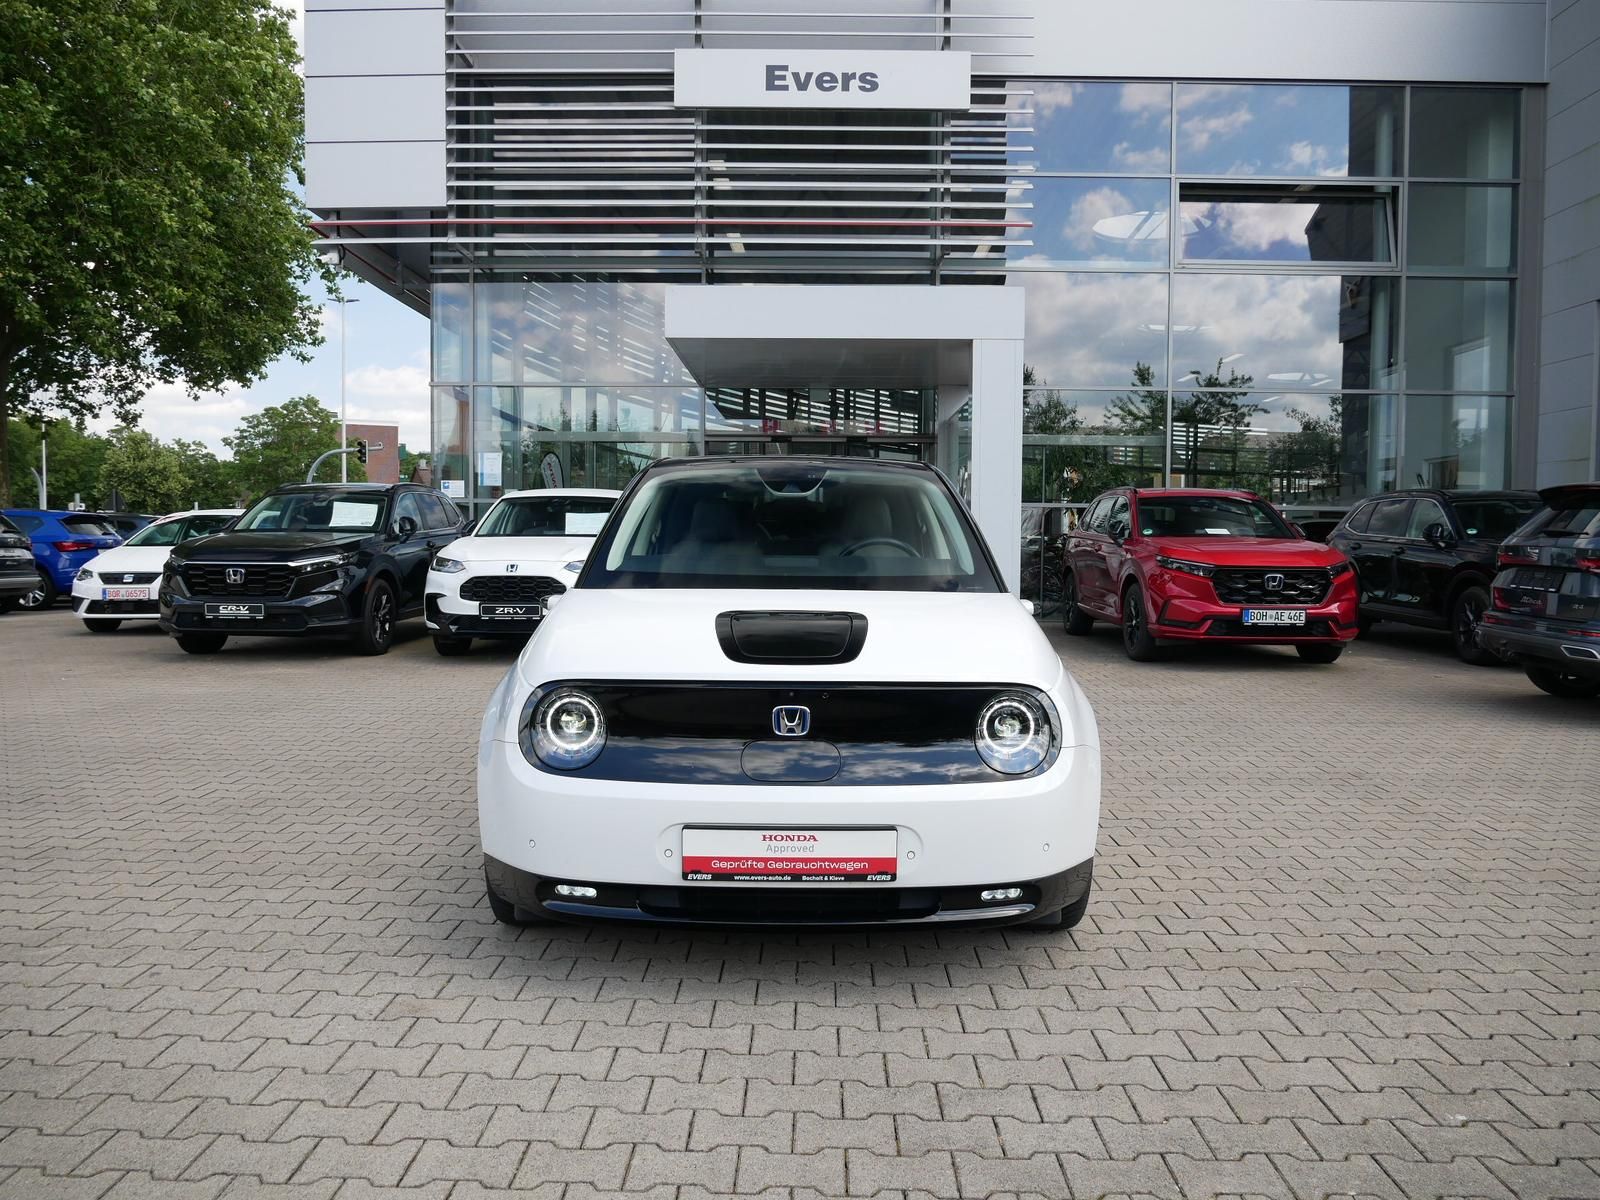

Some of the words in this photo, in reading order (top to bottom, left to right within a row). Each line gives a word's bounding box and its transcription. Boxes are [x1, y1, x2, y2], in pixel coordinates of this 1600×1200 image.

[765, 64, 880, 93] Evers
[1250, 611, 1268, 621] BOH
[1274, 611, 1286, 622] AE
[1287, 611, 1304, 622] 46E
[761, 834, 819, 842] HONDA
[766, 844, 815, 854] Approved
[711, 859, 765, 870] Geprüfte
[767, 860, 869, 871] Gebrauchtwagen
